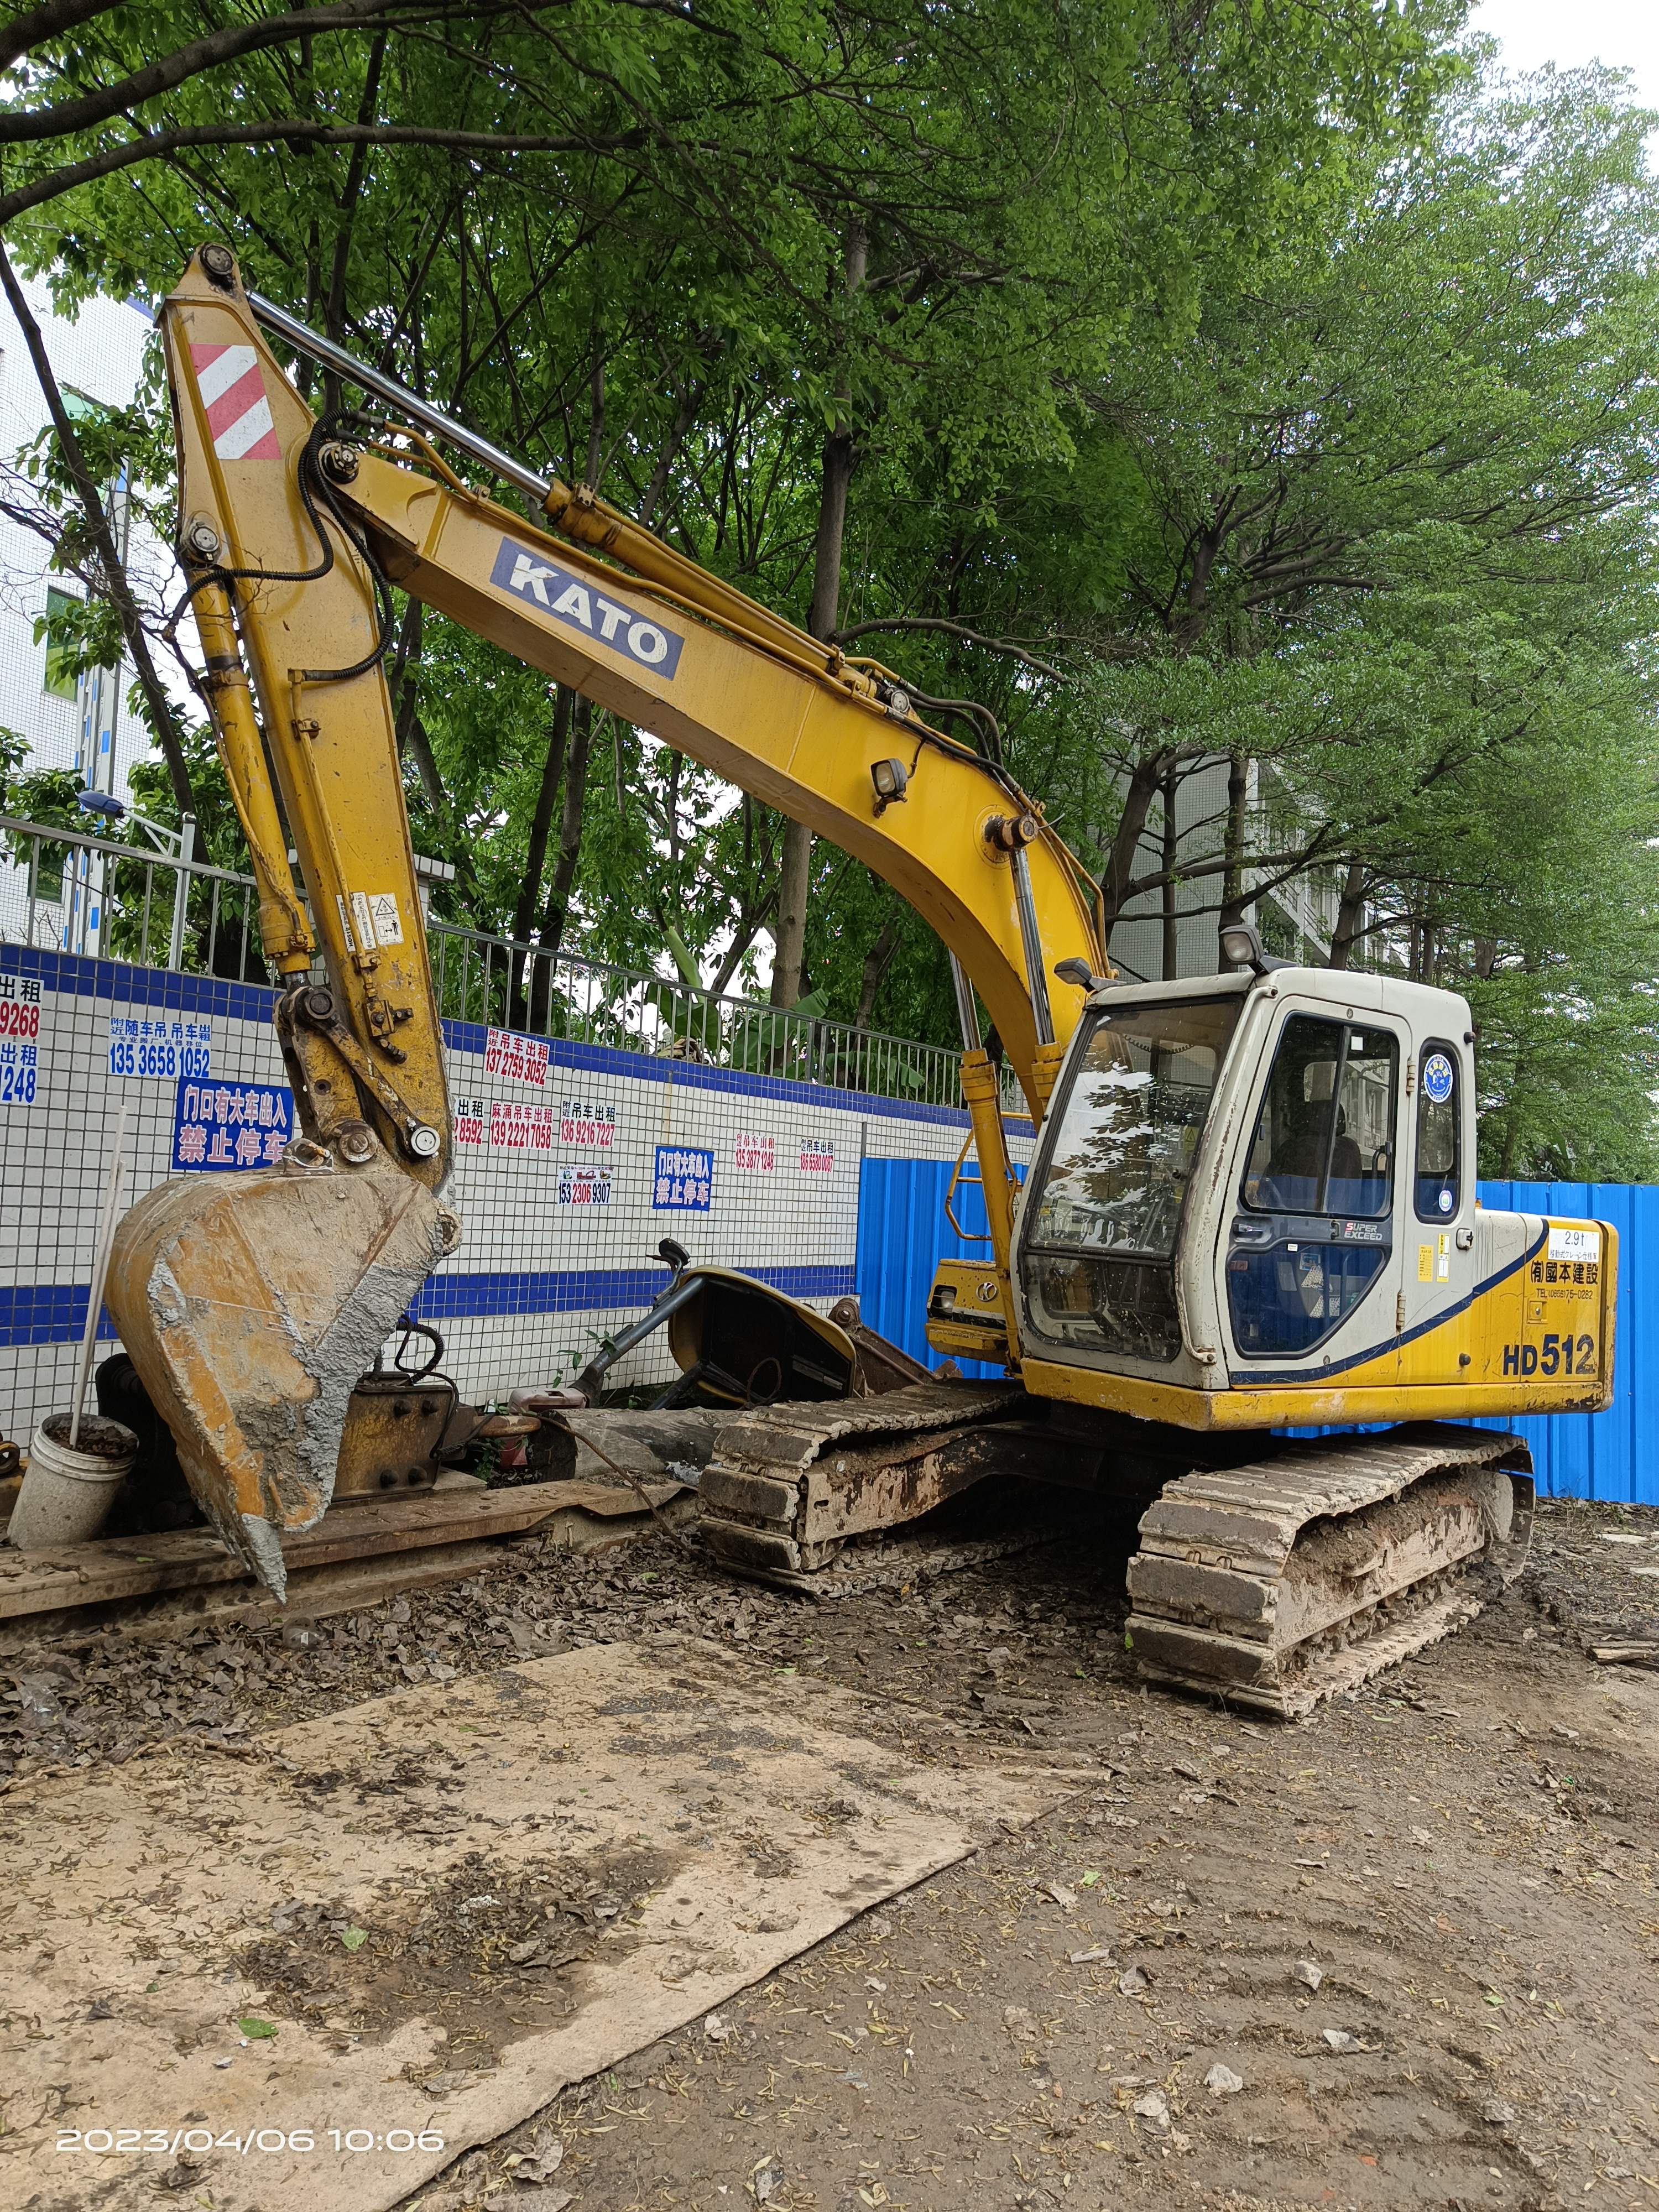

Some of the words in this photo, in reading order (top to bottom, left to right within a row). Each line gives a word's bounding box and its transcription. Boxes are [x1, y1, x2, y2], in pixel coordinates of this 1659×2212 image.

[509, 554, 668, 664] KATO
[0, 975, 41, 1003] 出租
[0, 1001, 40, 1038] 9268
[0, 1042, 38, 1066] 出租
[111, 1042, 134, 1074] 135
[138, 1045, 175, 1076] 3658
[179, 1047, 210, 1078] 1052
[486, 1047, 502, 1073] 137
[501, 1051, 524, 1079] 2759
[524, 1058, 547, 1086] 3052
[183, 1083, 287, 1128] 门口有大车出入
[458, 1099, 483, 1118] 出租
[492, 1102, 552, 1123] 麻涌吊车出租
[178, 1123, 287, 1166] 禁止停车
[460, 1118, 483, 1145] 8592
[491, 1120, 506, 1146] 139
[507, 1121, 530, 1147] 2221
[531, 1123, 551, 1149] 7058
[561, 1118, 575, 1142] 136
[576, 1120, 596, 1144] 9216
[597, 1123, 615, 1146] 7227
[659, 1150, 709, 1179] 门口有大车出入
[736, 1148, 745, 1168] 135
[559, 1183, 571, 1204] 153
[572, 1183, 591, 1203] 2306
[592, 1183, 611, 1203] 9307
[655, 1177, 709, 1206] 禁止停车
[1344, 1231, 1383, 1241] EXCEED
[1345, 1223, 1378, 1233] SUPER
[1503, 1334, 1596, 1375] HD512
